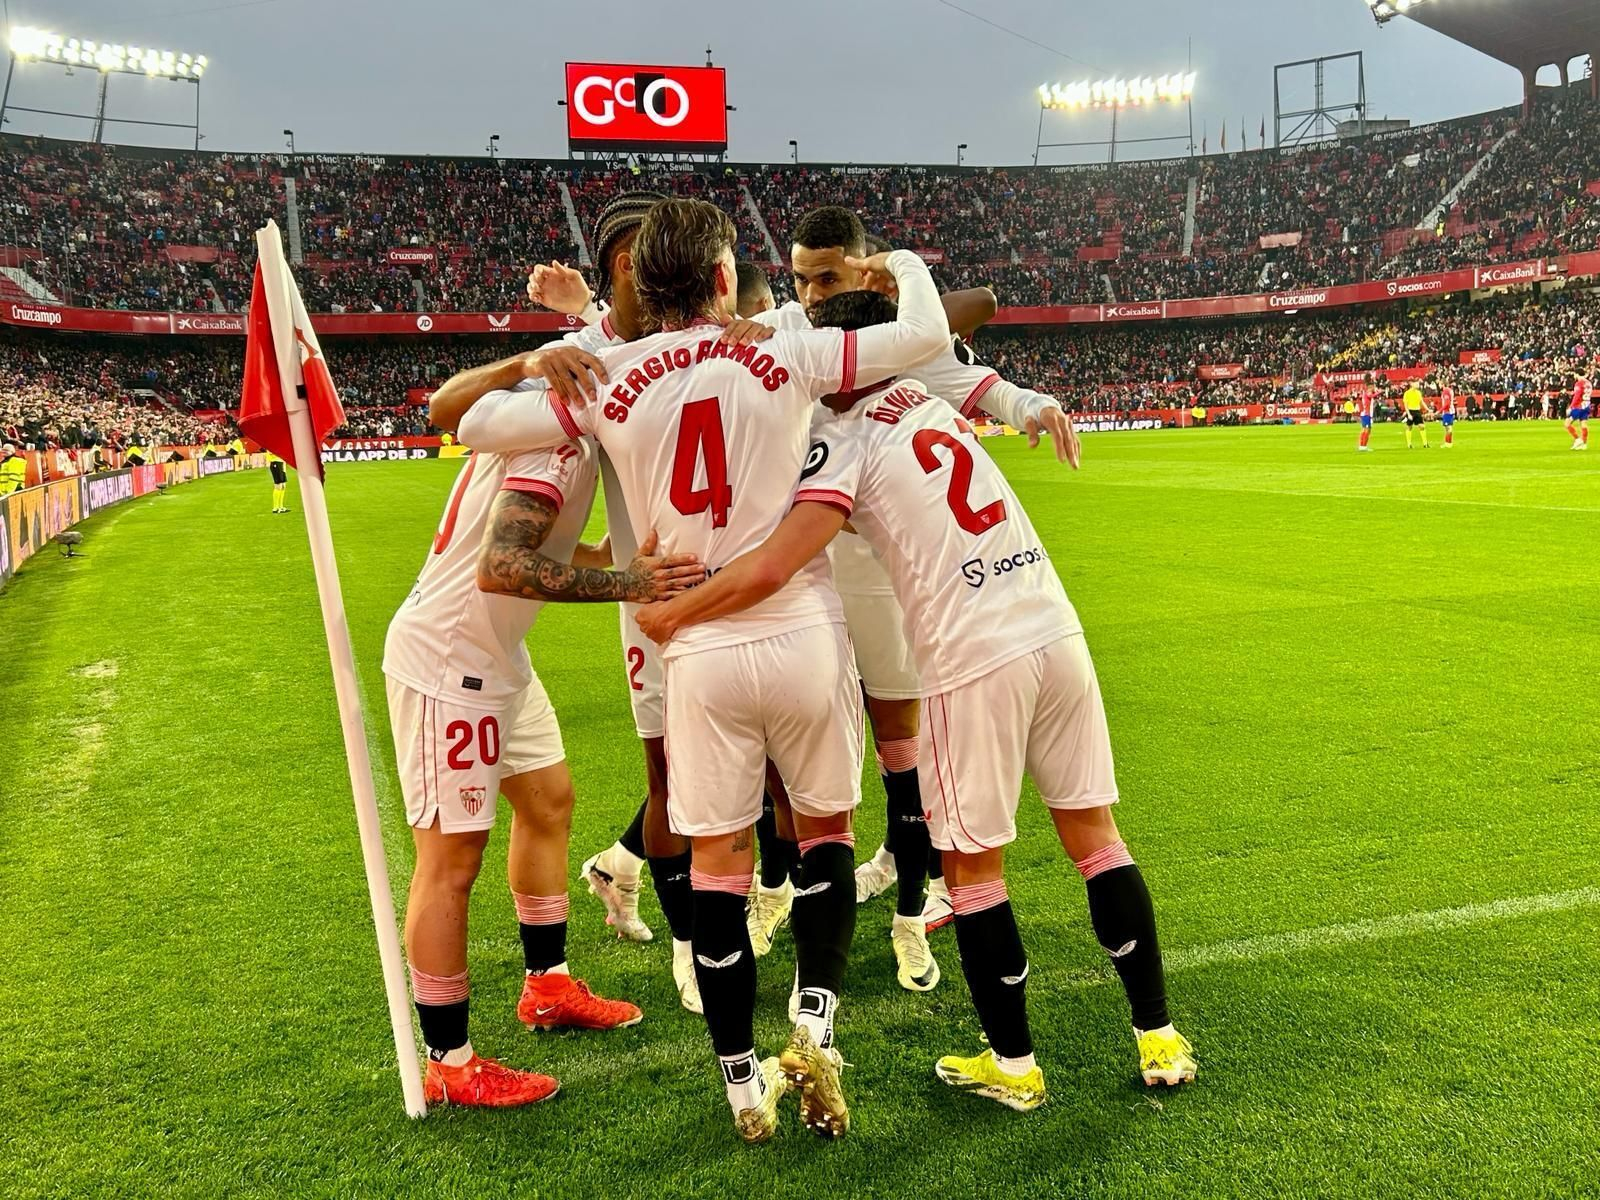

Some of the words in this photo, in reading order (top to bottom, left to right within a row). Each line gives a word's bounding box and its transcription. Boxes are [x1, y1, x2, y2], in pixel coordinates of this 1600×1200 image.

[260, 154, 289, 163] Seilla
[390, 251, 434, 261] Cruzcampo
[1493, 266, 1536, 282] CaixaBank
[1269, 292, 1326, 308] Cruzcampo
[11, 304, 62, 325] Cruzcampo
[1118, 306, 1161, 317] CaixaBank
[192, 319, 242, 330] CaixaBank
[419, 319, 430, 327] JD
[603, 348, 691, 424] SERGIO
[695, 339, 790, 392] RAMOS
[1099, 421, 1114, 432] EN
[1115, 420, 1130, 431] LA
[1131, 419, 1154, 430] APP
[335, 451, 355, 461] LA
[357, 450, 386, 461] APP
[389, 449, 407, 460] DE
[410, 449, 427, 459] JD
[669, 396, 733, 530] 4
[627, 646, 645, 691] 2
[446, 715, 501, 770] 20
